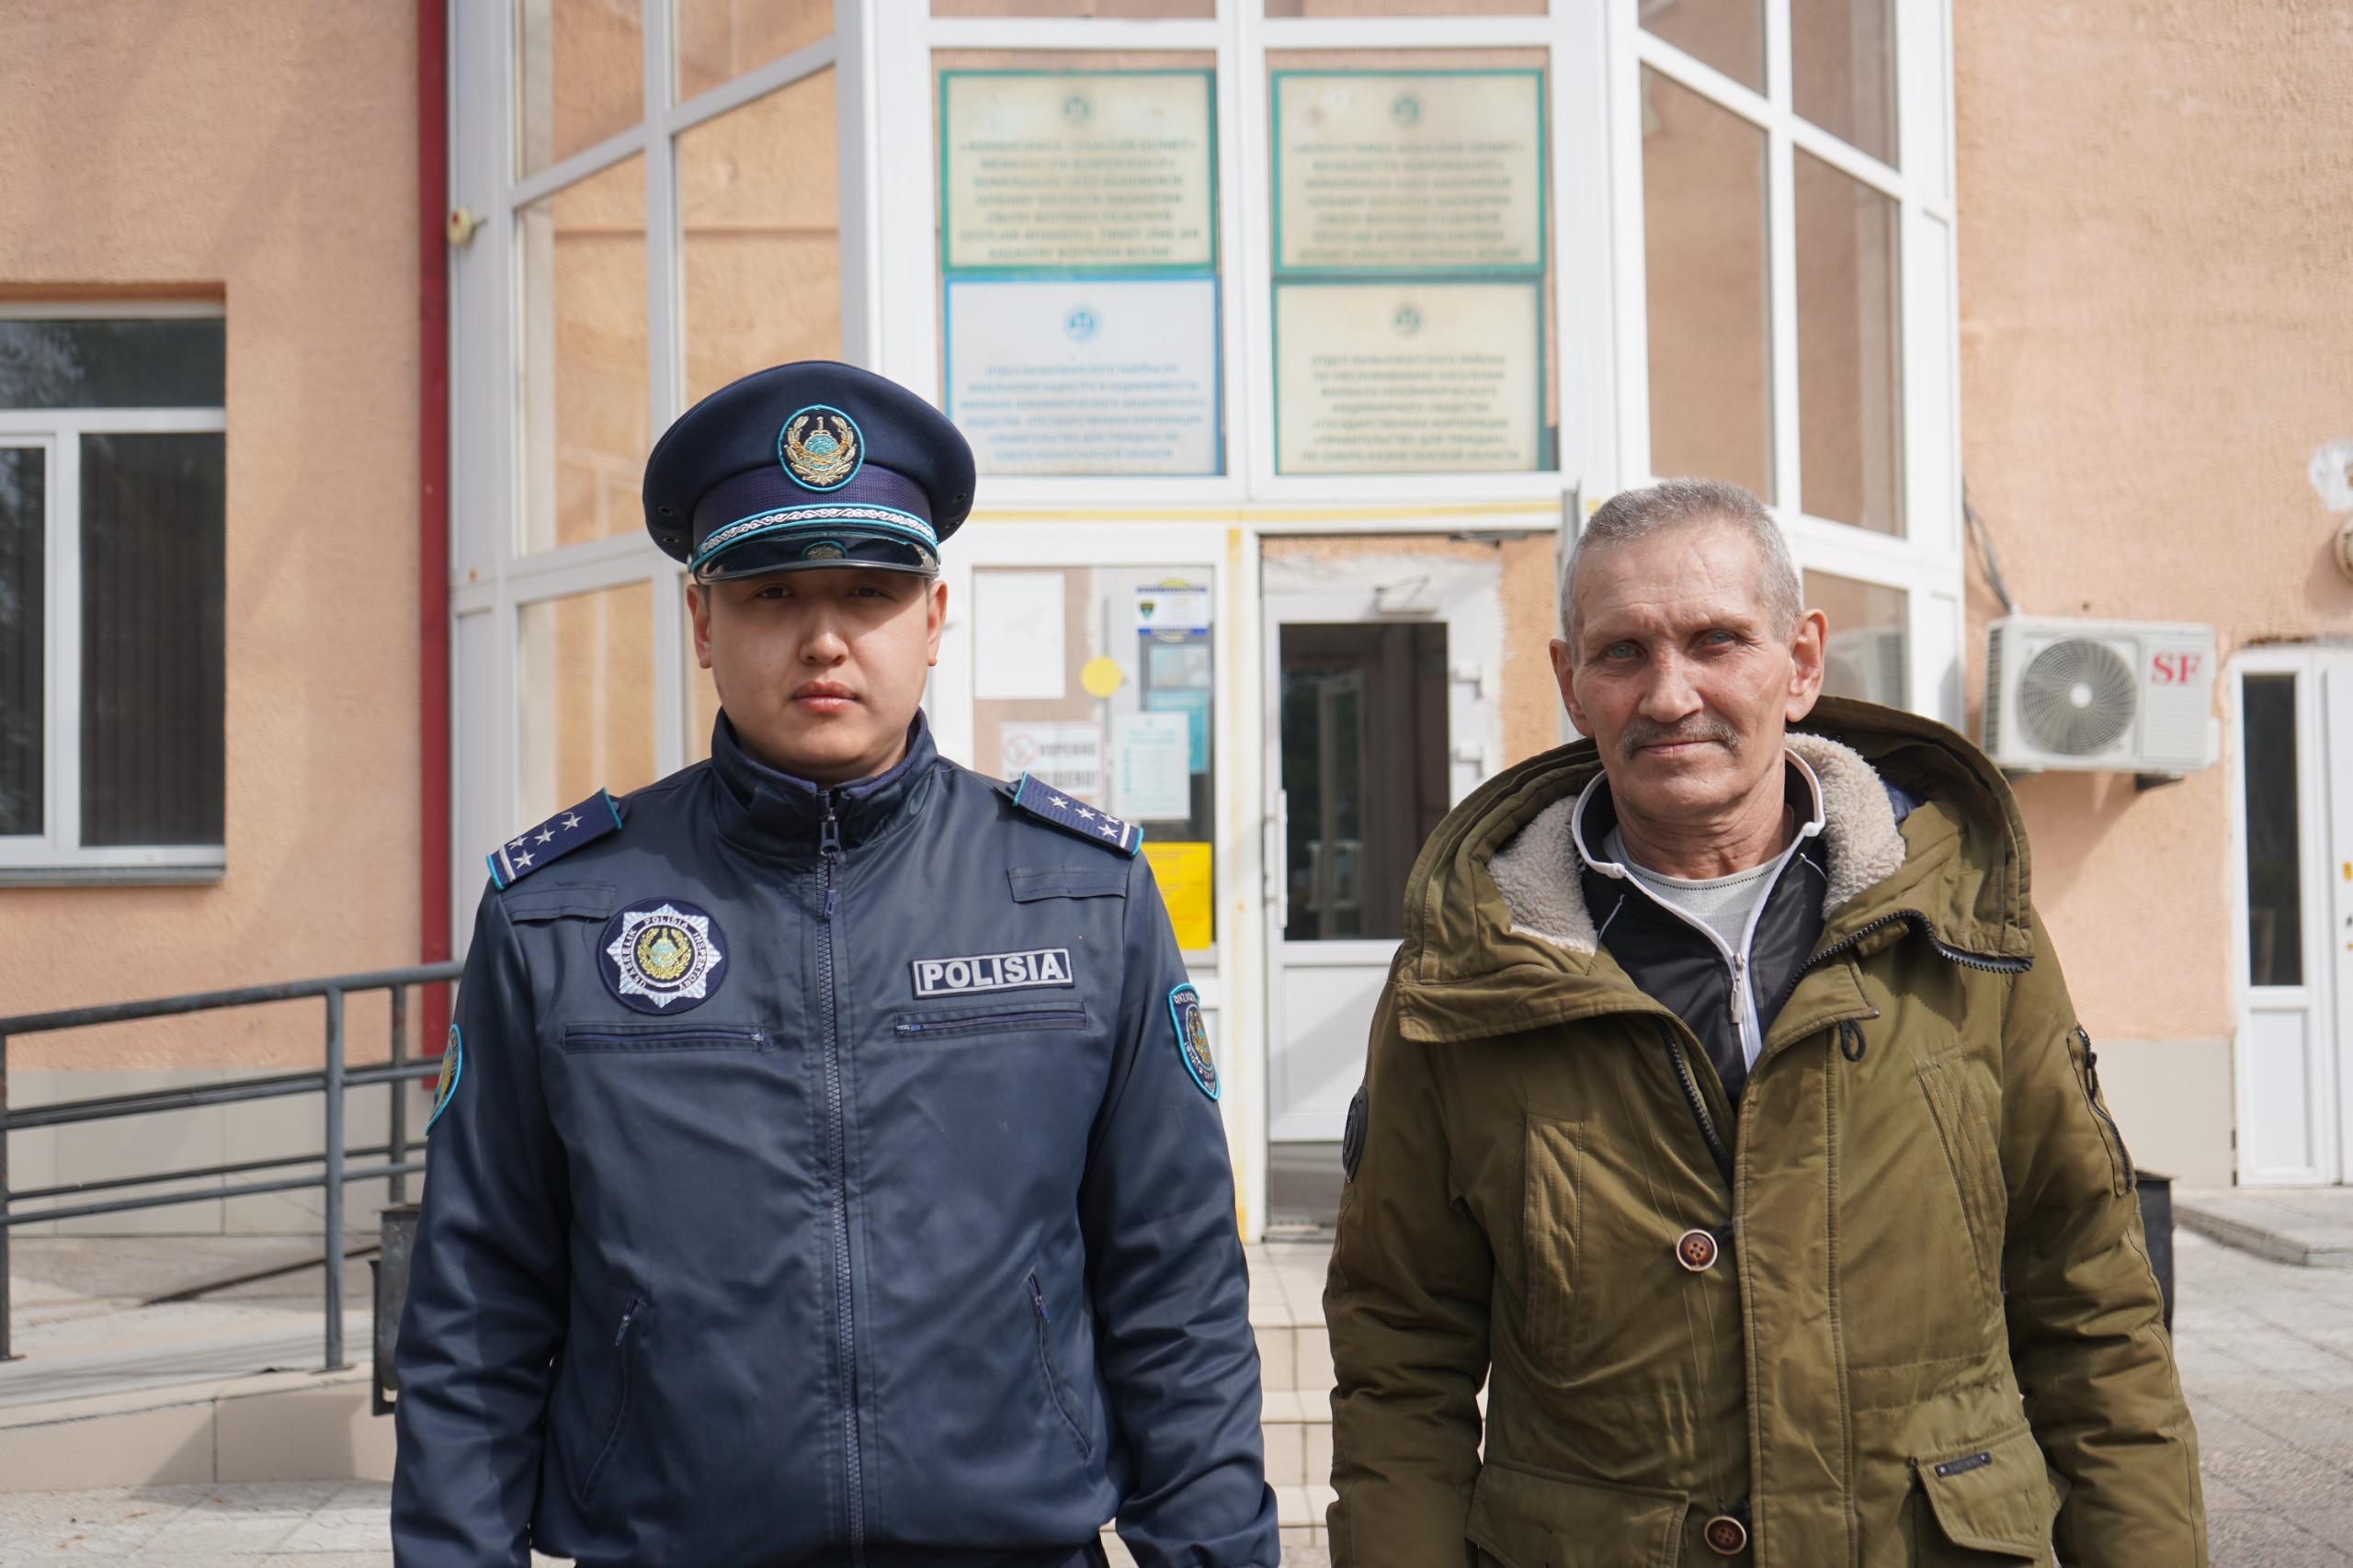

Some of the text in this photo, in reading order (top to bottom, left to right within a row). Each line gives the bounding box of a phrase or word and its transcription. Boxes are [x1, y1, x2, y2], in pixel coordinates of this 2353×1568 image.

[2151, 653, 2201, 687] SF
[644, 916, 688, 929] POLISIA
[922, 953, 1065, 991] POLISIA
